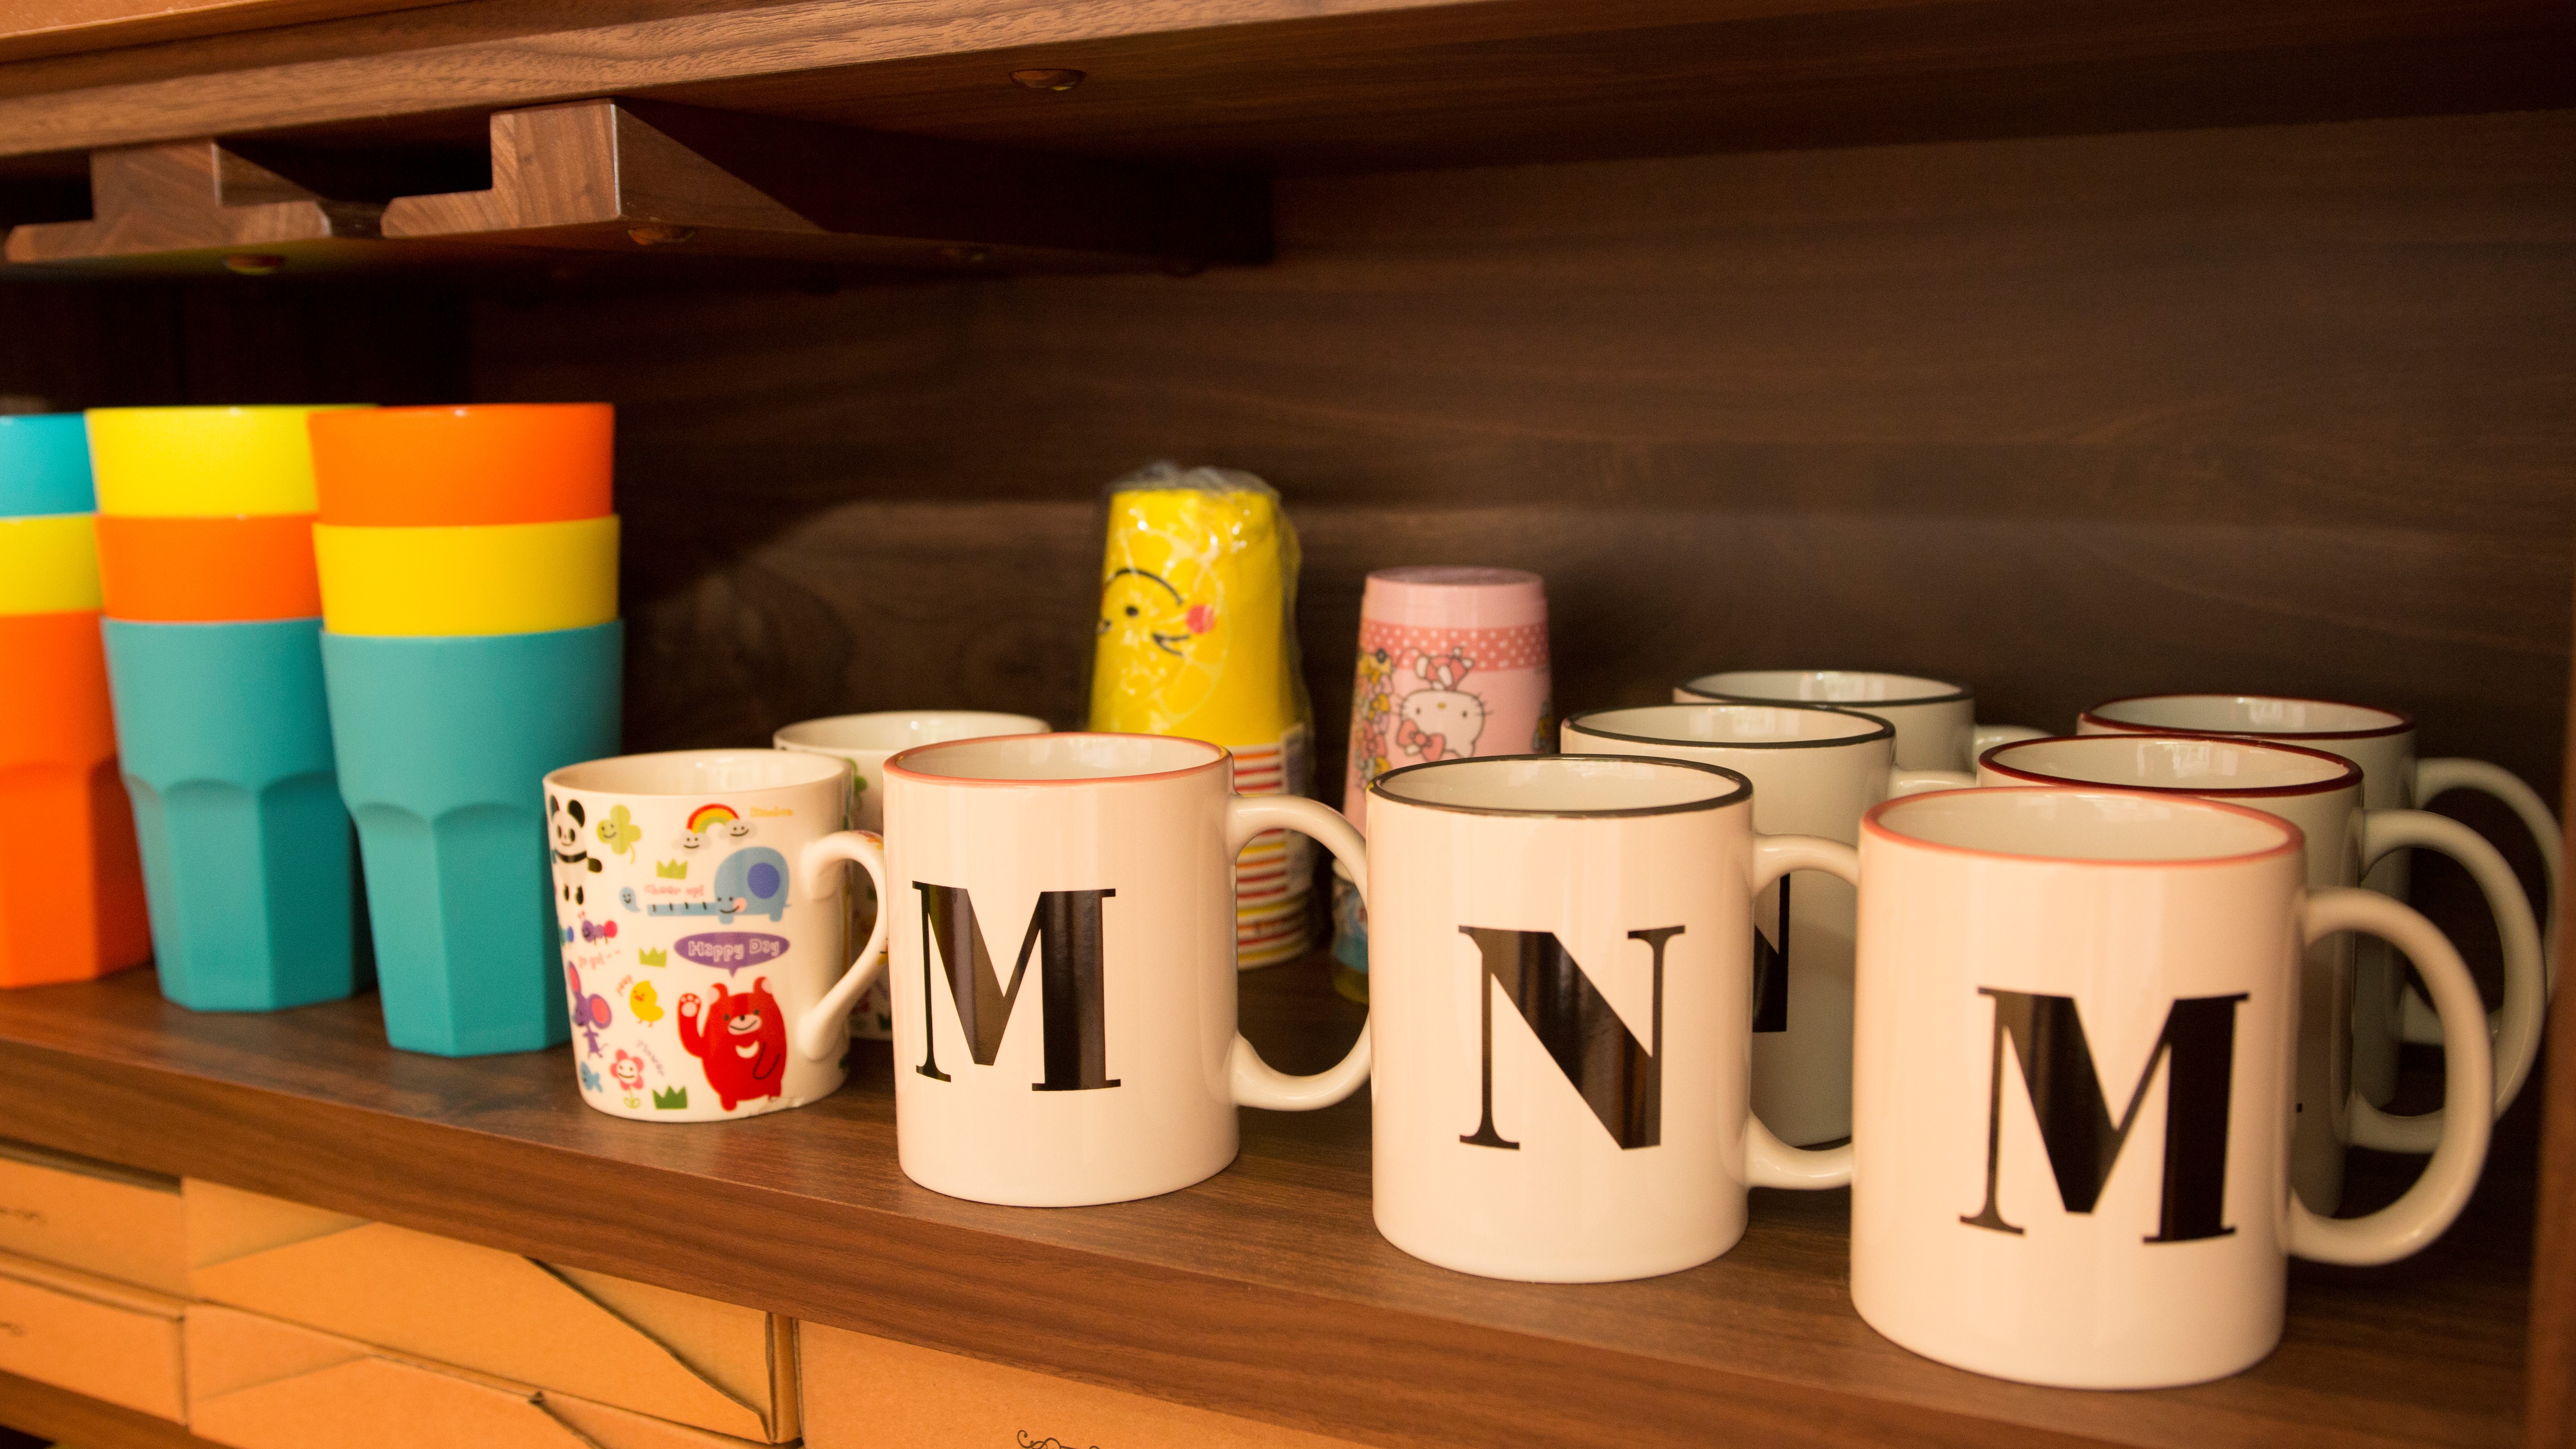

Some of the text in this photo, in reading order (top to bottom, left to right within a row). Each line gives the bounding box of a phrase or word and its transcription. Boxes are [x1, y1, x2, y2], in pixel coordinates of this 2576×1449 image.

[644, 884, 681, 895] Cheer
[688, 938, 780, 962] Happy Day
[912, 881, 1121, 1091] M
[1460, 925, 1685, 1149] N
[1961, 988, 2250, 1244] M
